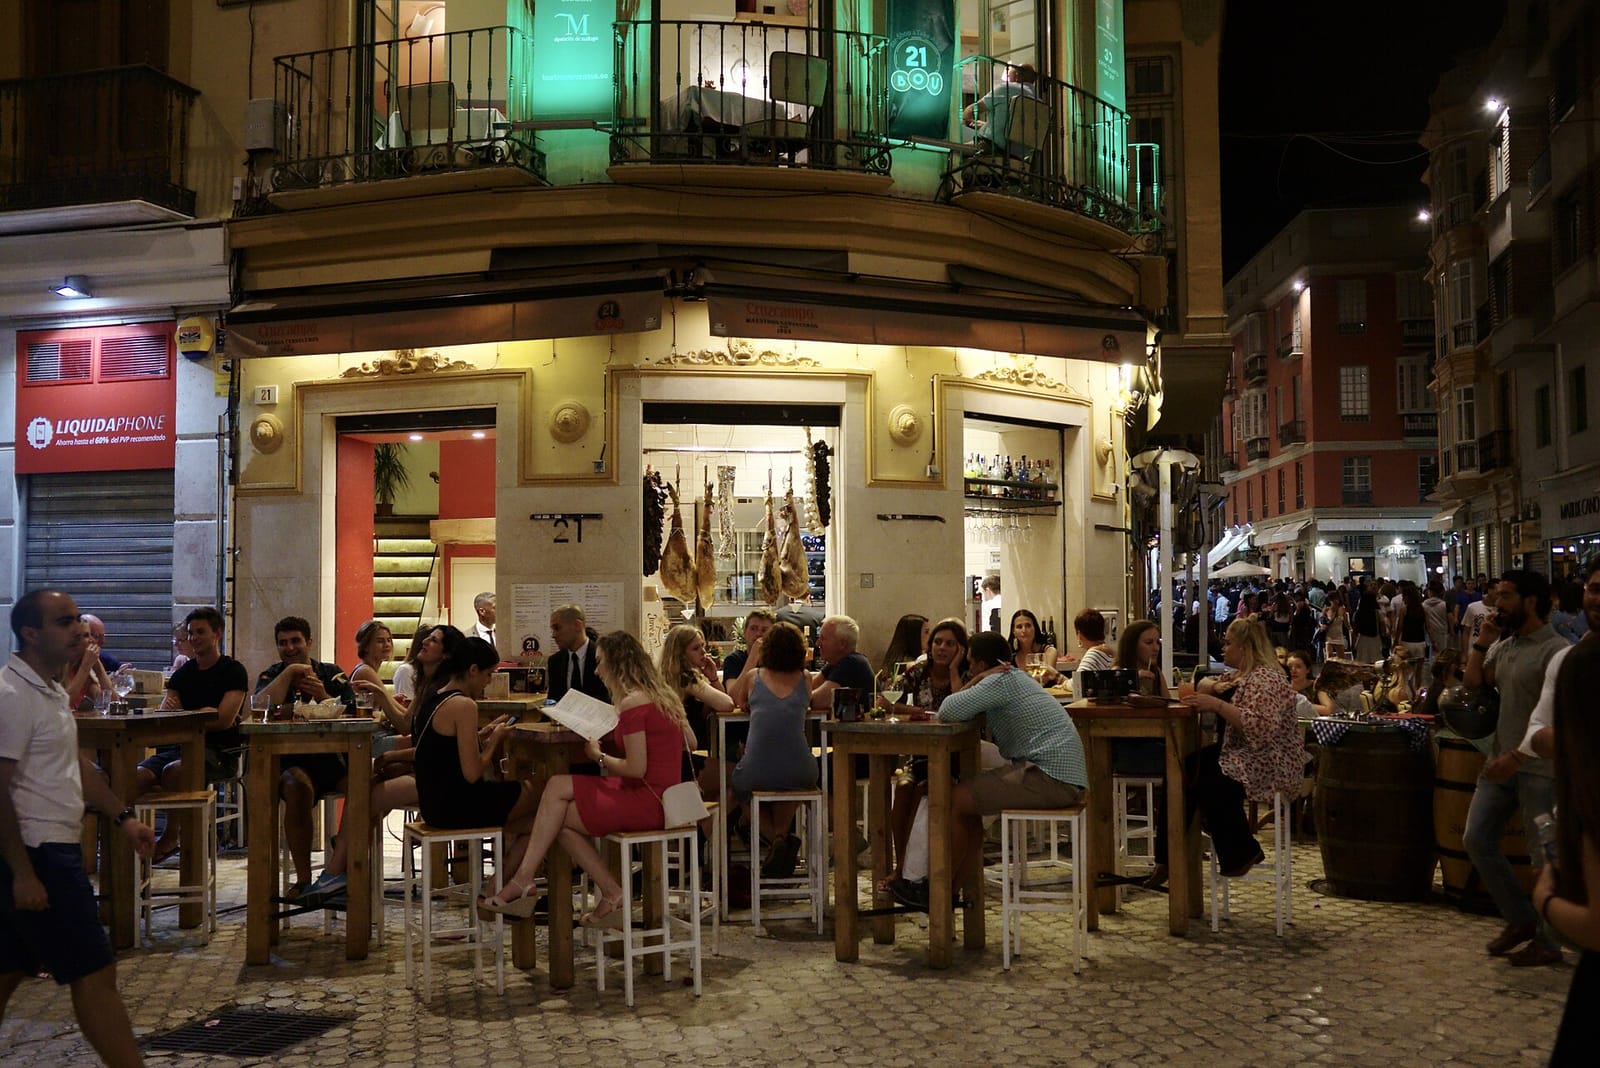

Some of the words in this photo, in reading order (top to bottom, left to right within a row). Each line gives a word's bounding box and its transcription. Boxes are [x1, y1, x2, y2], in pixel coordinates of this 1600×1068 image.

[905, 45, 927, 67] 21
[602, 304, 614, 316] 21
[261, 389, 271, 401] 21
[56, 415, 165, 436] LIQUIDAPHONE
[95, 436, 109, 445] 60%
[110, 436, 119, 444] del
[130, 434, 166, 443] recomendado
[553, 518, 582, 543] 21
[526, 640, 535, 649] 21
